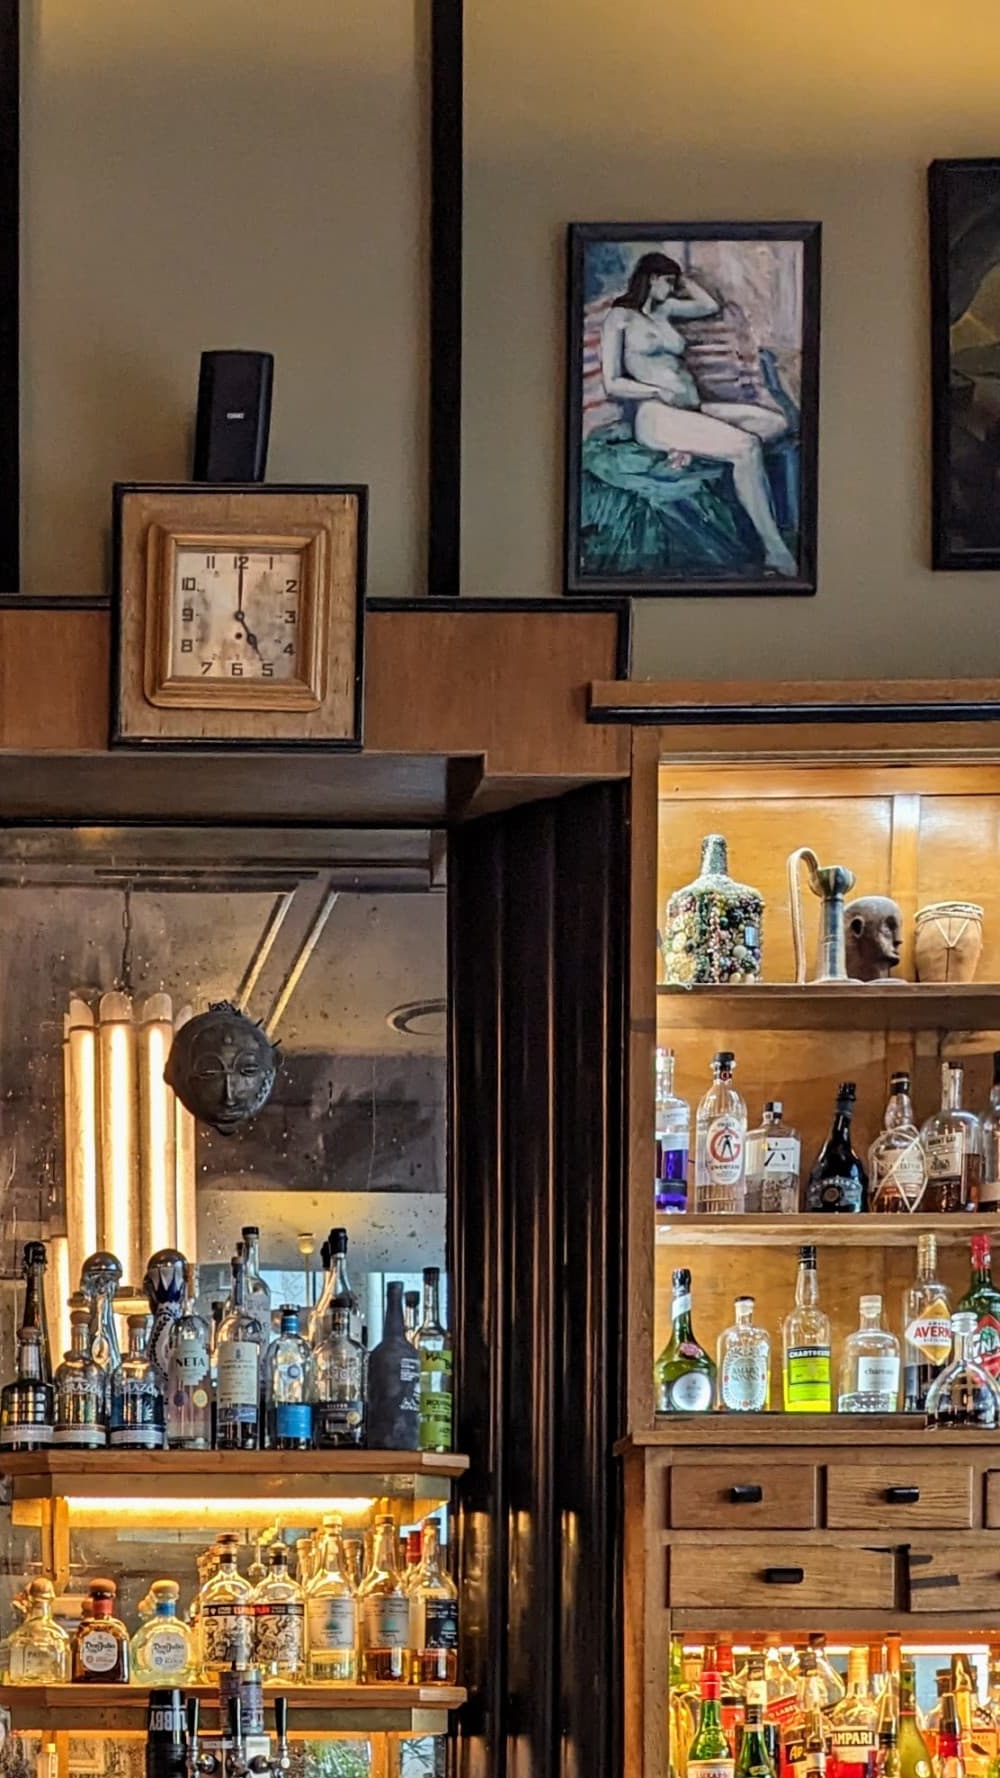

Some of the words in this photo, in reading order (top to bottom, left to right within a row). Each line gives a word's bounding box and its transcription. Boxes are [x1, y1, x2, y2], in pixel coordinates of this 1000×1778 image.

[205, 556, 216, 569] 11
[233, 556, 249, 570] 12
[268, 556, 274, 570] 1
[181, 577, 197, 592] 10
[285, 579, 298, 594] 2
[182, 608, 194, 622] 9
[284, 610, 297, 625] 3
[180, 639, 193, 653] 8
[283, 642, 296, 656] 4
[201, 662, 213, 675] 7
[231, 663, 243, 676] 6
[261, 663, 274, 677] 5
[175, 1358, 205, 1368] NETA
[834, 1731, 873, 1745] AMPARI
